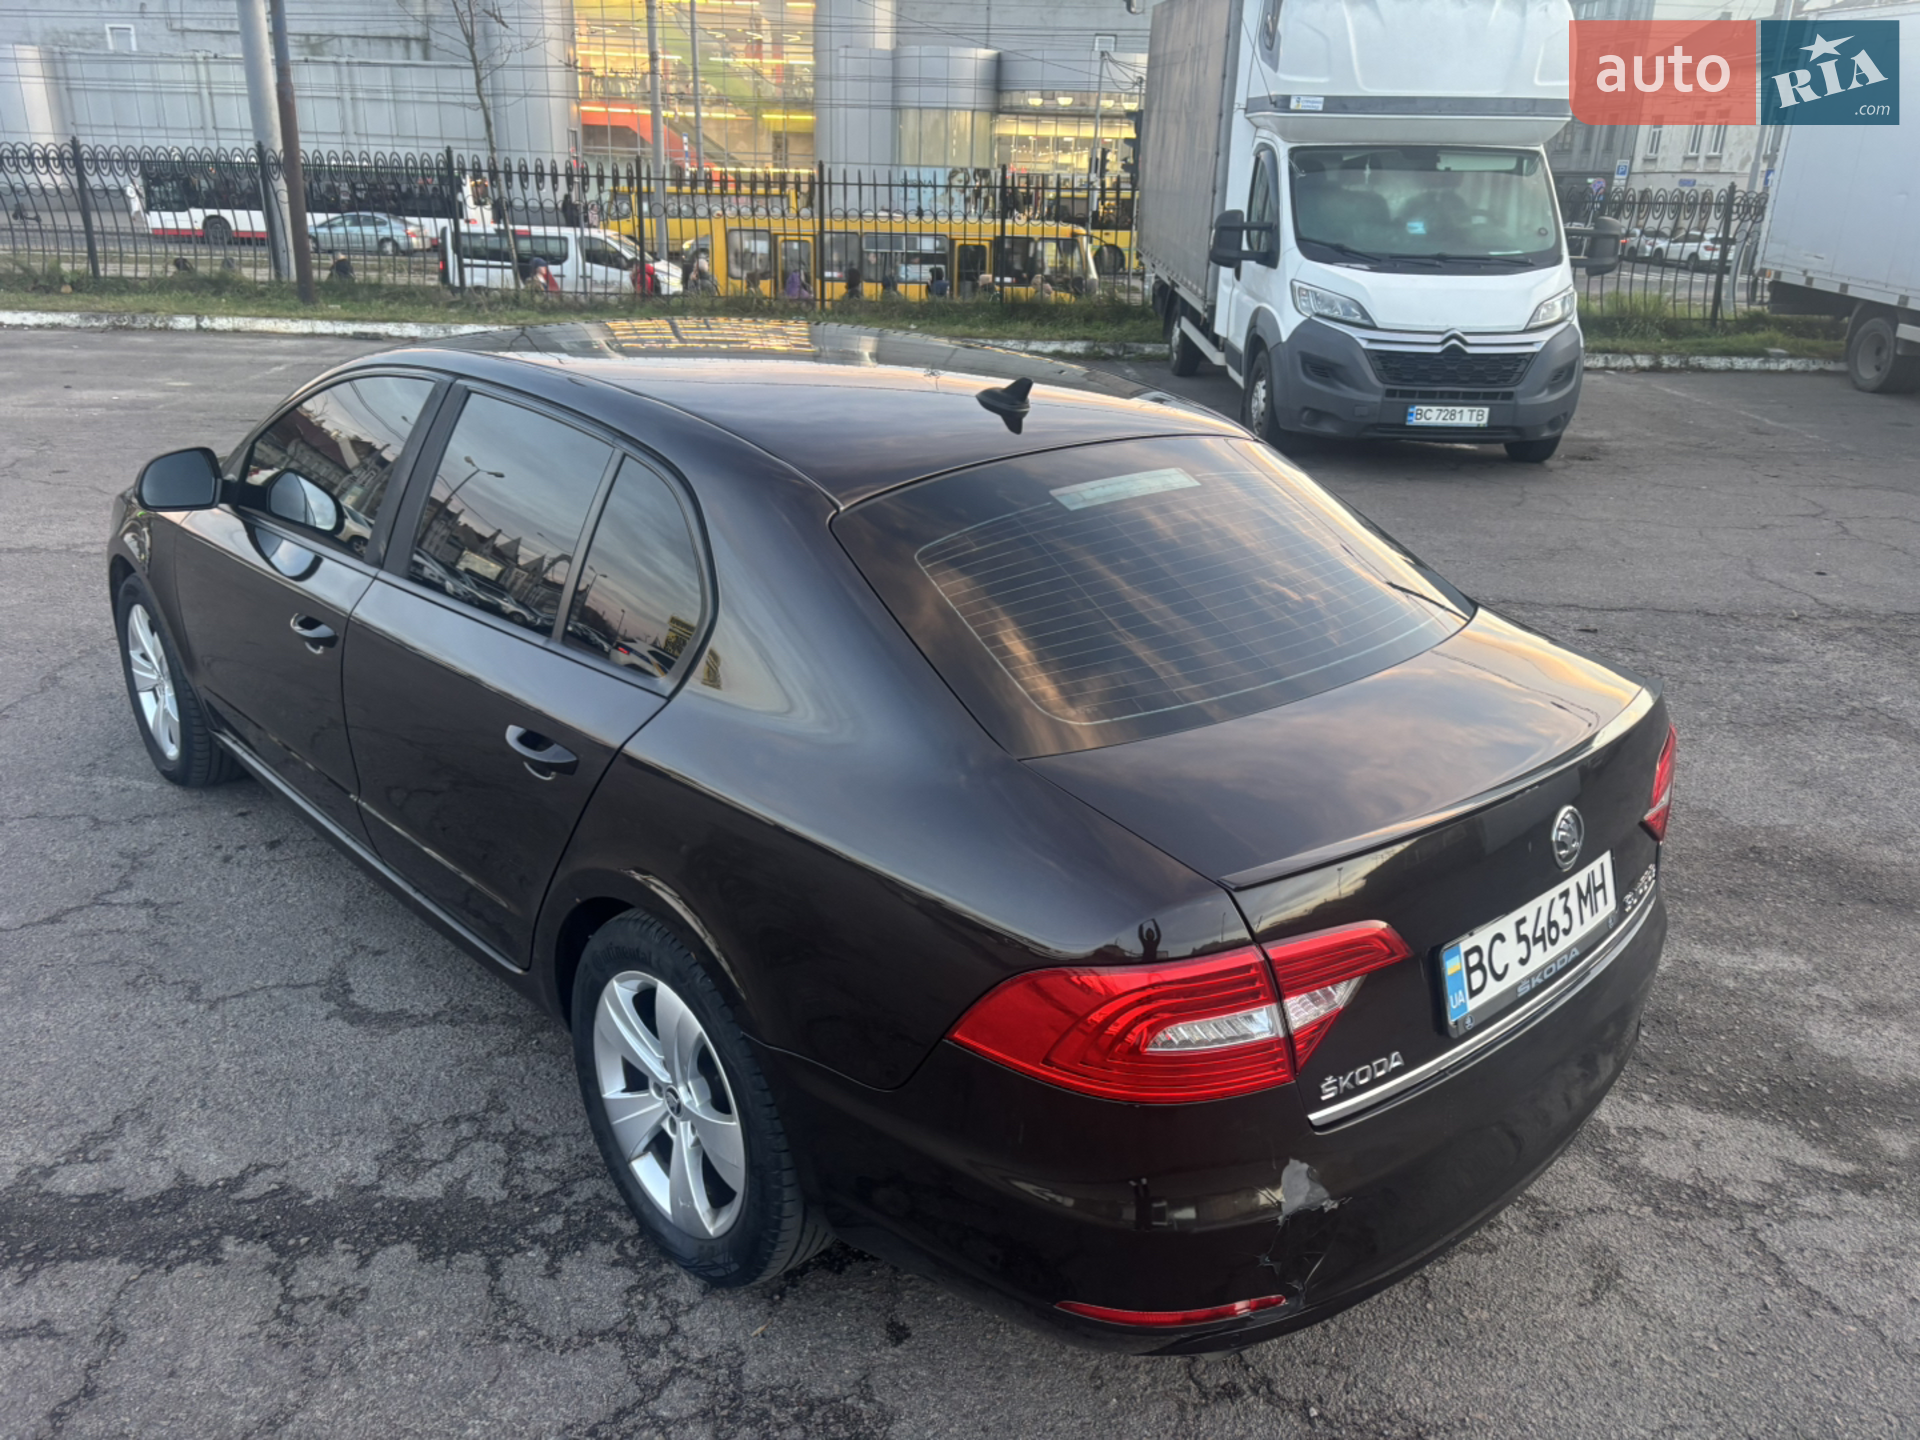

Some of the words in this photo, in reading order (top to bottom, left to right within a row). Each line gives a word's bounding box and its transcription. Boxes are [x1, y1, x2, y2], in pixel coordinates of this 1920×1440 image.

[1415, 408, 1433, 421] BC
[1435, 408, 1464, 422] 7281
[1467, 409, 1486, 422] TB
[1463, 932, 1509, 1000] BC
[1514, 887, 1574, 966] 5463
[1575, 861, 1608, 927] MH
[1516, 947, 1580, 998] ŠKODA
[1449, 990, 1466, 1009] UA
[1320, 1051, 1405, 1100] ŠKODA
